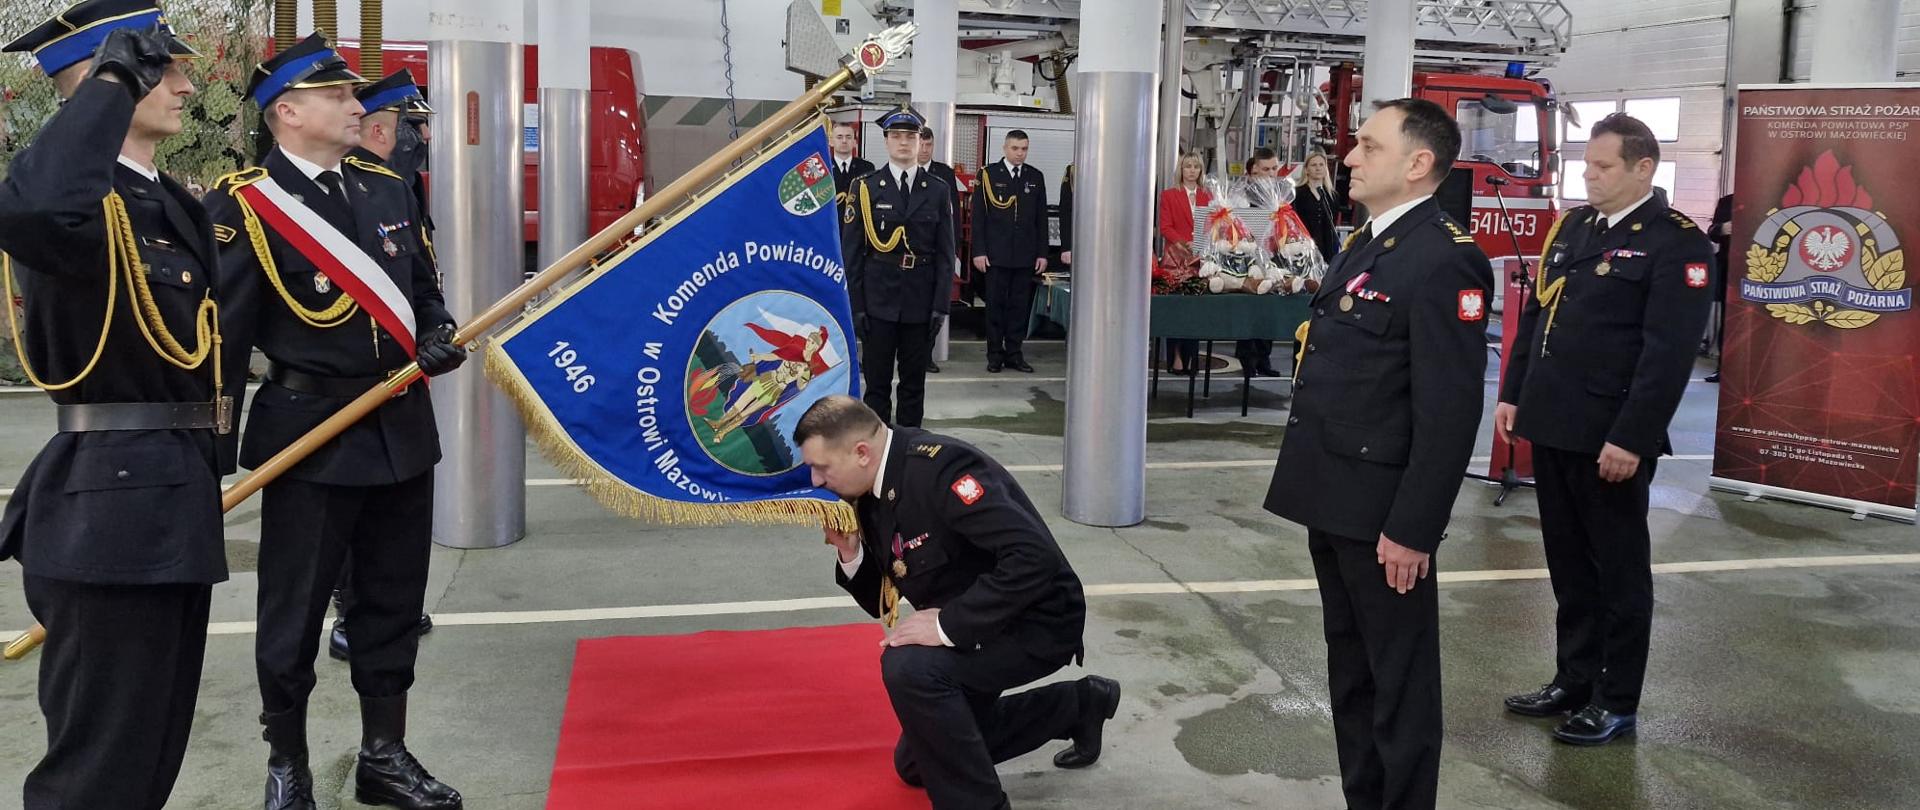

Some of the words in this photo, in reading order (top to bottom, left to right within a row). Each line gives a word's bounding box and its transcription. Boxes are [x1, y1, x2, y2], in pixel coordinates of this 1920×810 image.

[1743, 105, 1827, 116] PAŃSTWOWA
[1830, 104, 1871, 116] STRAŻ
[1767, 121, 1818, 130] KOMENDA
[1821, 121, 1885, 130] POWIATOWA
[1889, 121, 1909, 131] PSP
[1768, 130, 1778, 139] W
[1781, 130, 1827, 139] OSTROWI
[1830, 130, 1907, 140] MAZOWIECKIEJ
[1513, 213, 1537, 237] 53
[652, 251, 740, 326] Komenda
[745, 240, 846, 284] Powiatowa
[1743, 284, 1807, 300] PAŃSTWOWA
[1810, 281, 1842, 296] STRAŻ
[1847, 290, 1905, 308] POŻARNA
[643, 342, 663, 361] w
[548, 341, 596, 393] 1946
[636, 367, 668, 451] Ostrowi
[1759, 448, 1787, 458] 07-300
